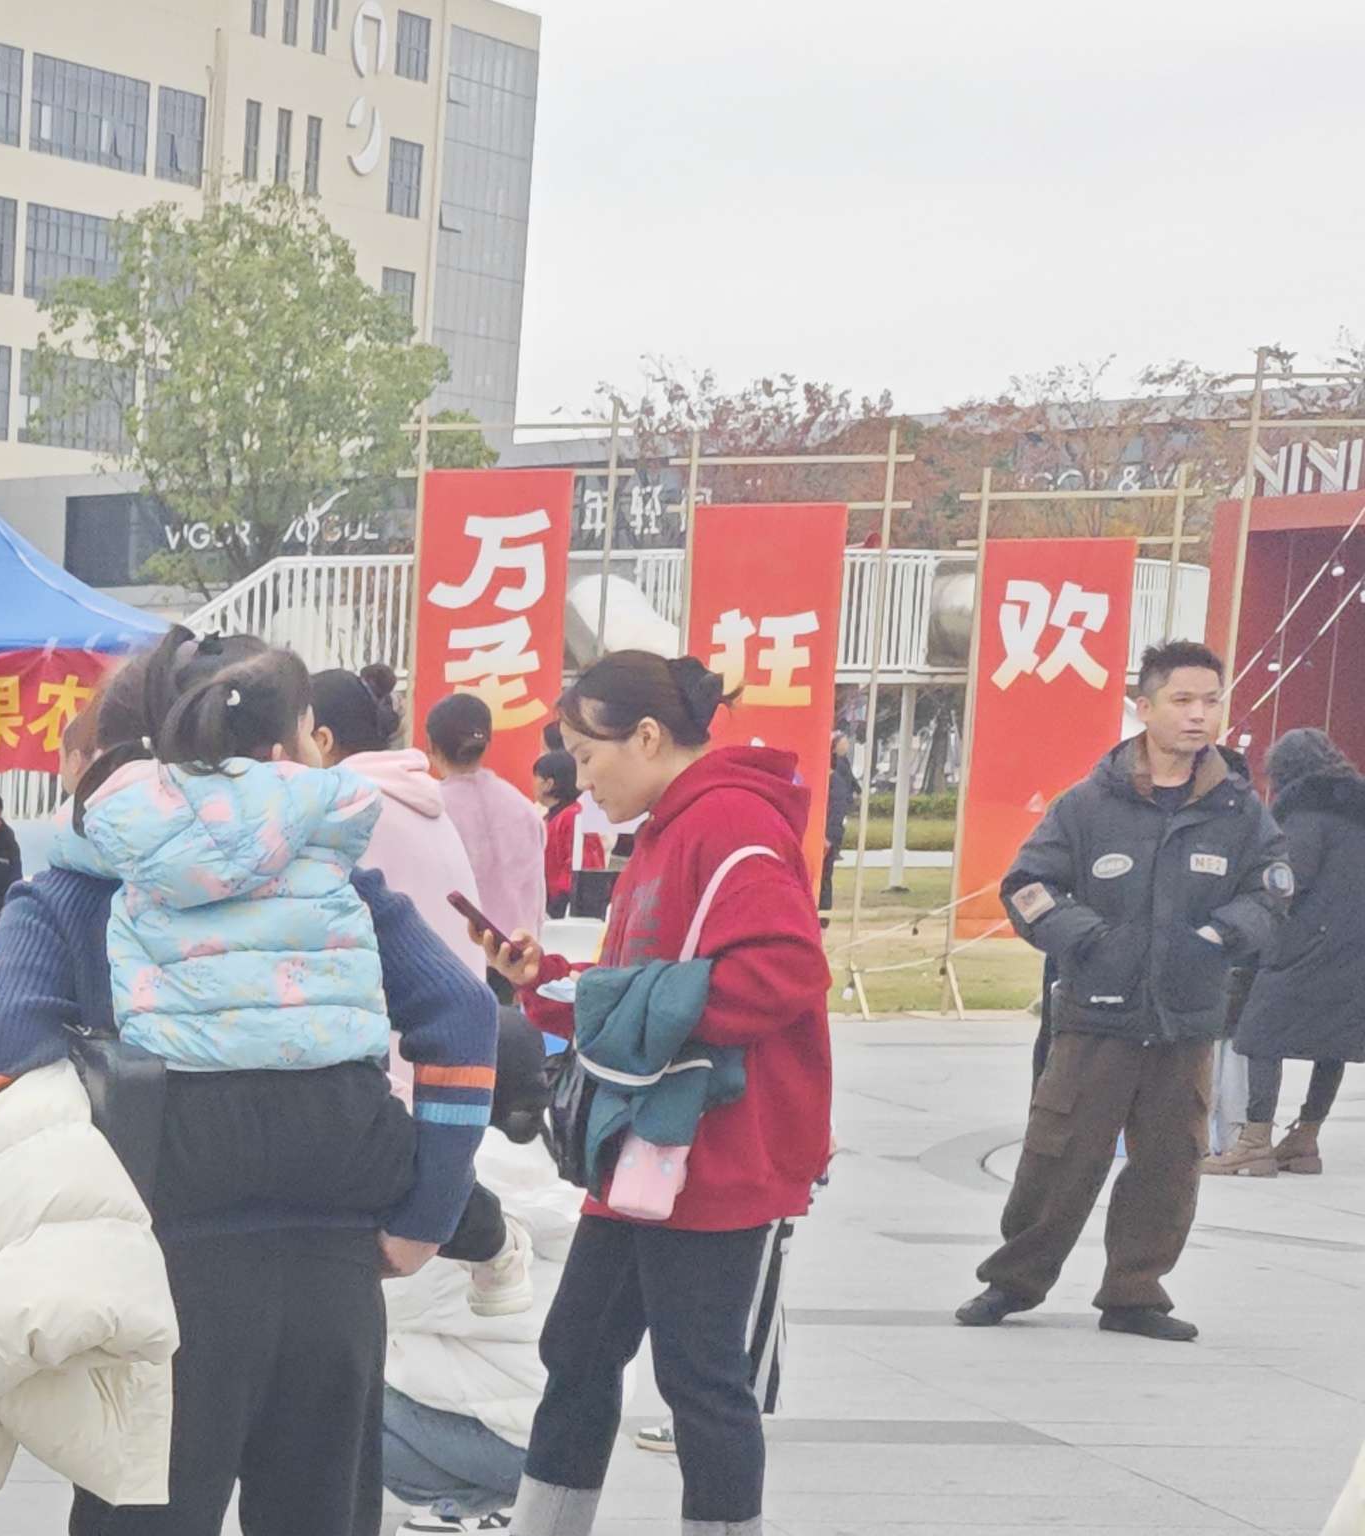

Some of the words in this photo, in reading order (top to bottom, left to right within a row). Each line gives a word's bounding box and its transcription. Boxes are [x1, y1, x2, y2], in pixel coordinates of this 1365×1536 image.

[427, 508, 552, 731] 万圣
[709, 608, 820, 706] 狂
[991, 578, 1111, 692] 欢
